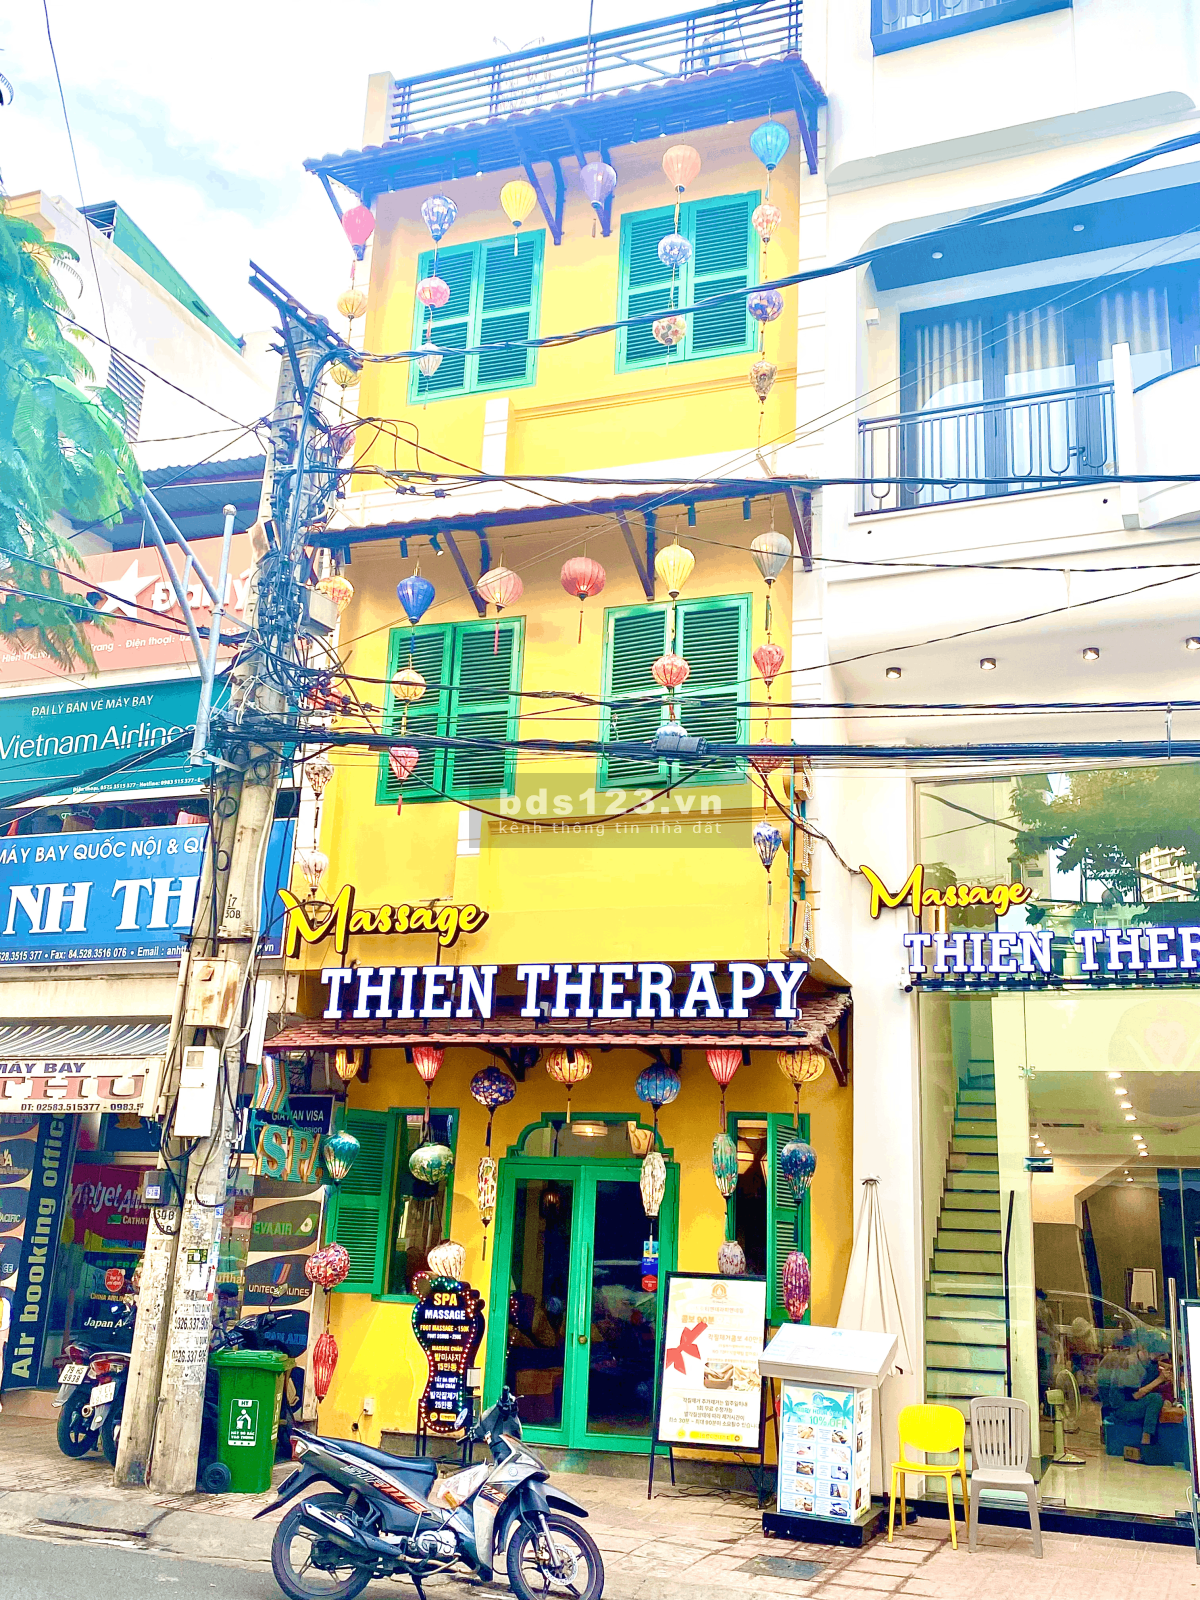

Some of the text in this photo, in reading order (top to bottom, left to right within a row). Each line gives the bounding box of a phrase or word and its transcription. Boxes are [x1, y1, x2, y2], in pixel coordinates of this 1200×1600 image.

[32, 704, 49, 718] ĐẠI
[51, 702, 64, 715] LÝ
[132, 695, 154, 707] BAY
[0, 733, 98, 760] Vietnam
[35, 845, 69, 863] BAY
[73, 836, 127, 860] QUỐC
[131, 836, 162, 860] NỘI
[166, 838, 179, 854] &
[859, 863, 1031, 919] Massage
[278, 884, 489, 958] Massage
[50, 950, 66, 959] Fax:
[137, 946, 159, 957] Email
[903, 931, 1055, 974] THIEN
[321, 961, 809, 1019] THIEN THERAPY
[44, 1062, 85, 1073] BAY
[36, 1103, 100, 1111] 02583.515377
[306, 1110, 324, 1121] VISA
[20, 1197, 57, 1322] booking
[433, 1293, 458, 1306] SPA
[84, 1317, 113, 1329] Japan
[425, 1309, 466, 1320] MASSAGE
[12, 1332, 35, 1379] Air
